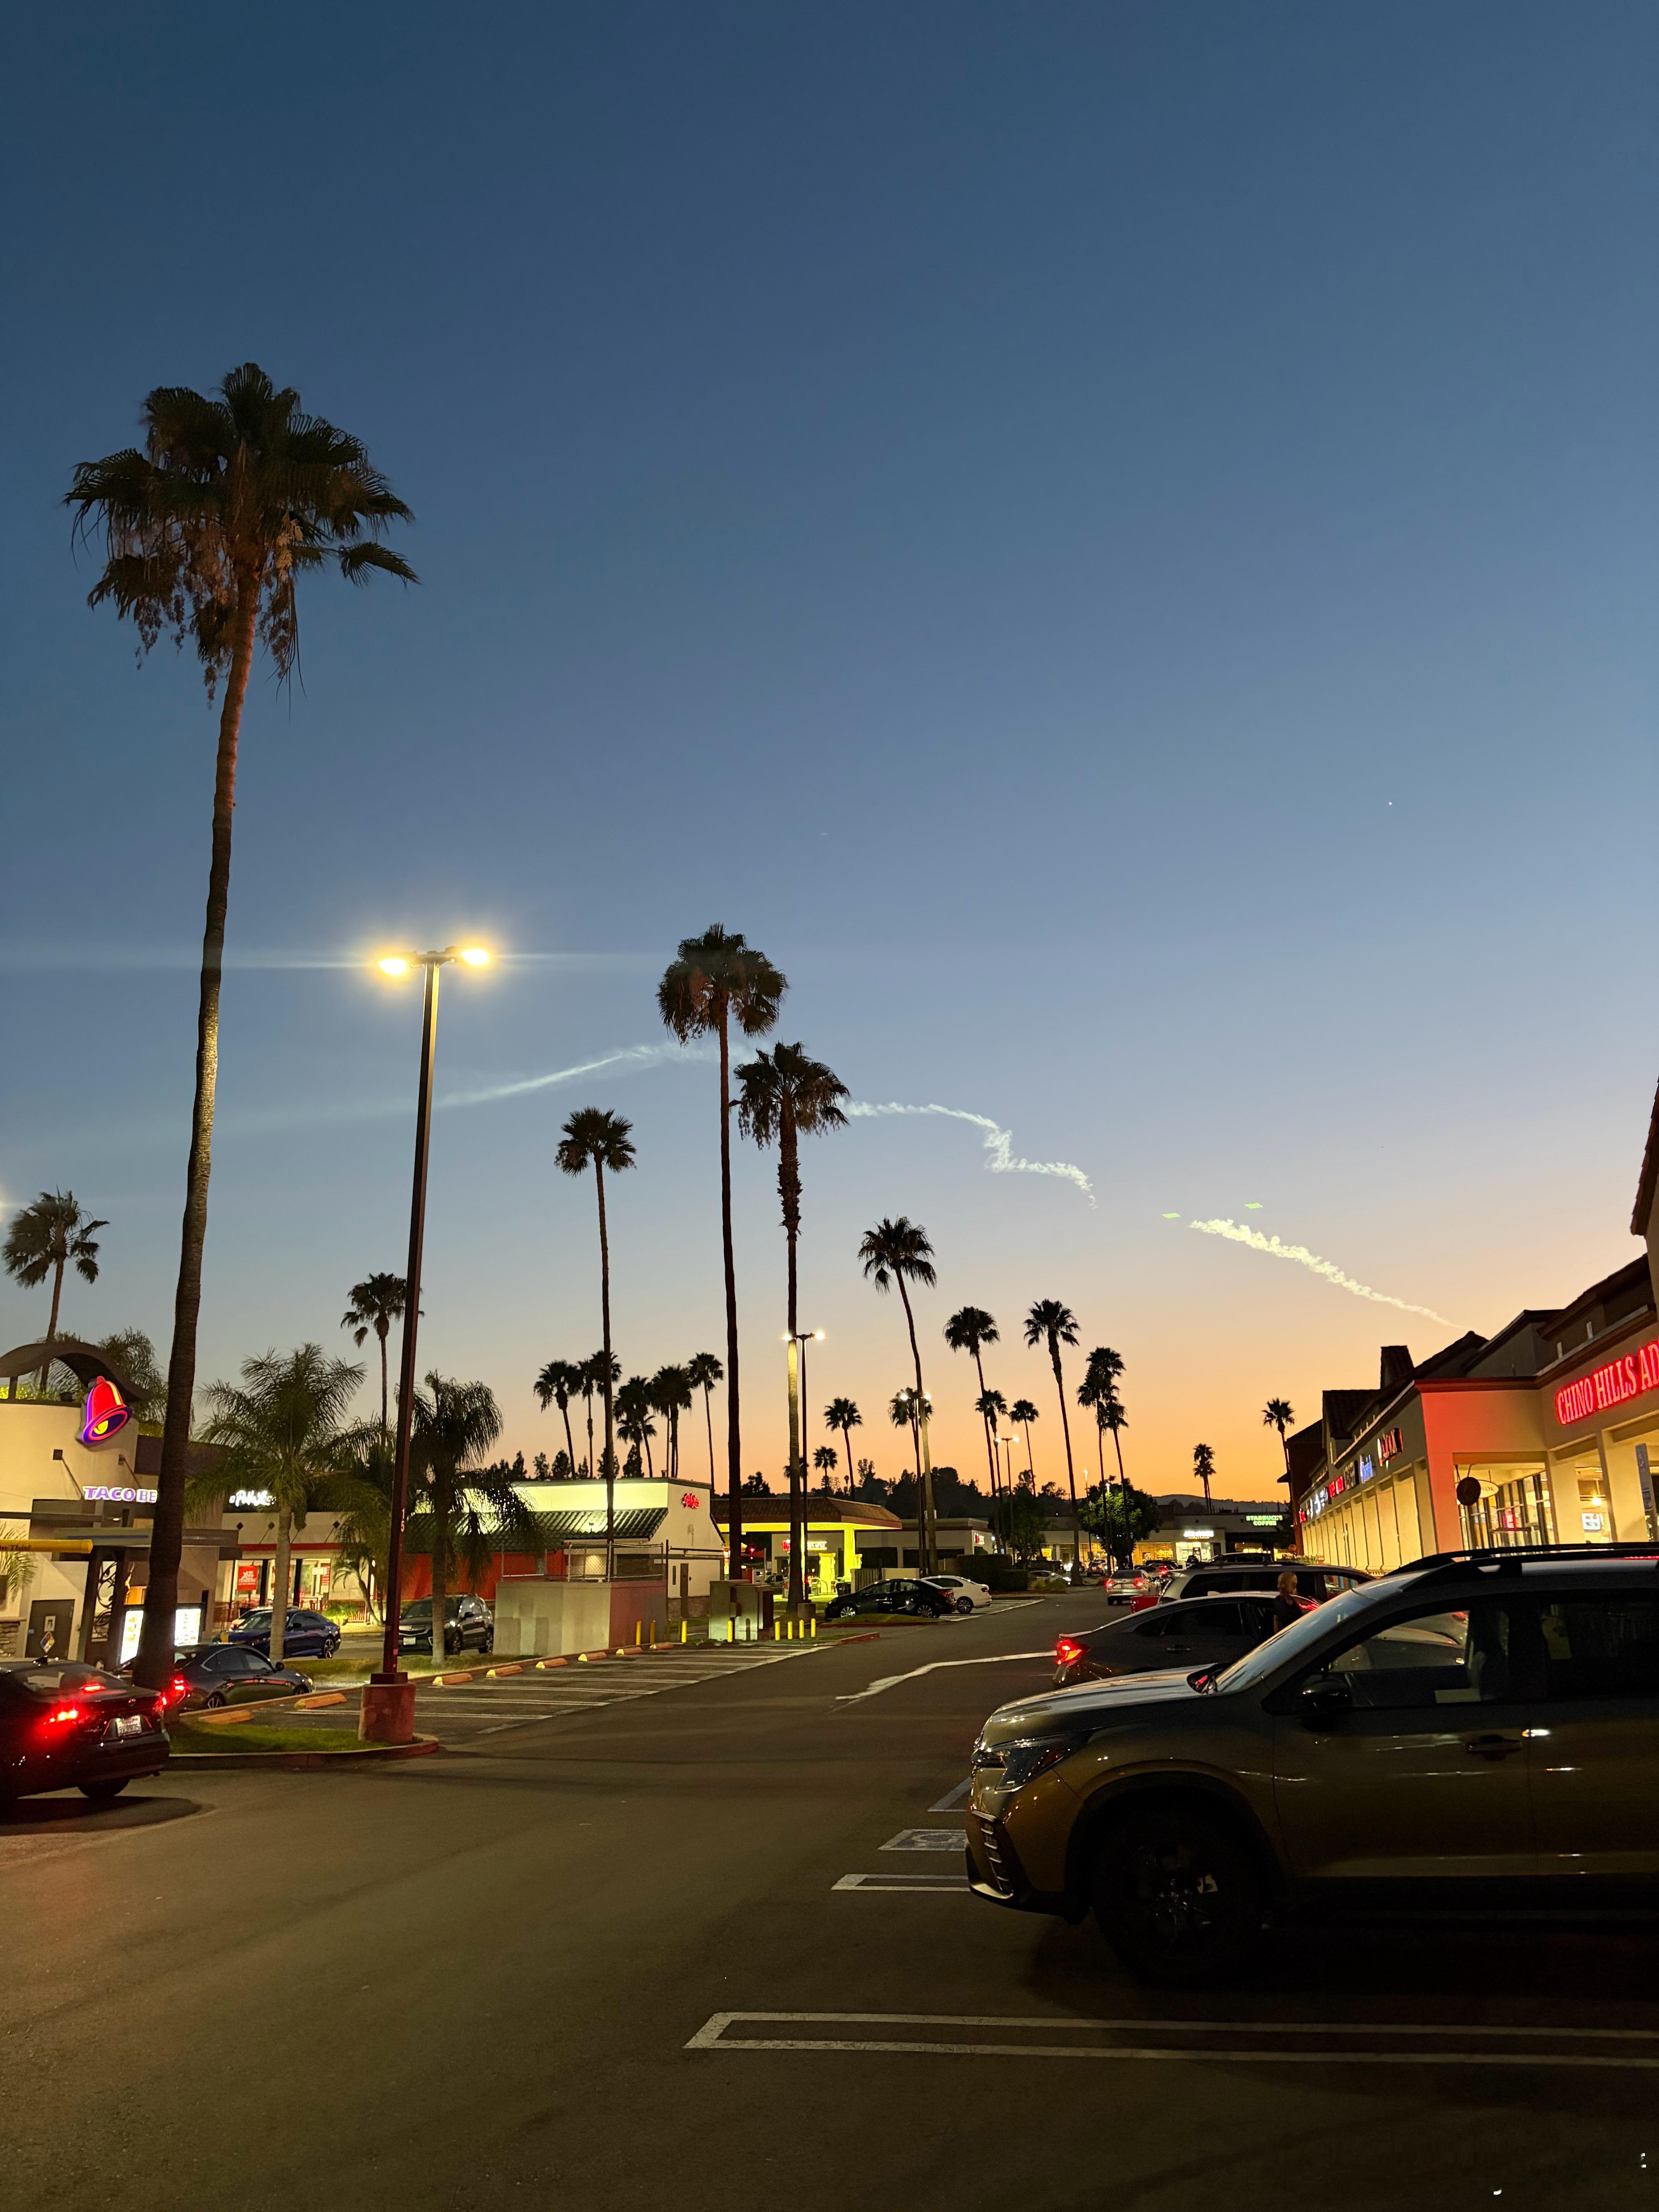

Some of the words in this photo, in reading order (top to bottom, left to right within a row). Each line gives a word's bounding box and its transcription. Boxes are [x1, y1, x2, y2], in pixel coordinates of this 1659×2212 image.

[1557, 1377, 1594, 1425] CHINO
[1593, 1355, 1637, 1410] HILLS
[82, 1486, 135, 1501] TACO
